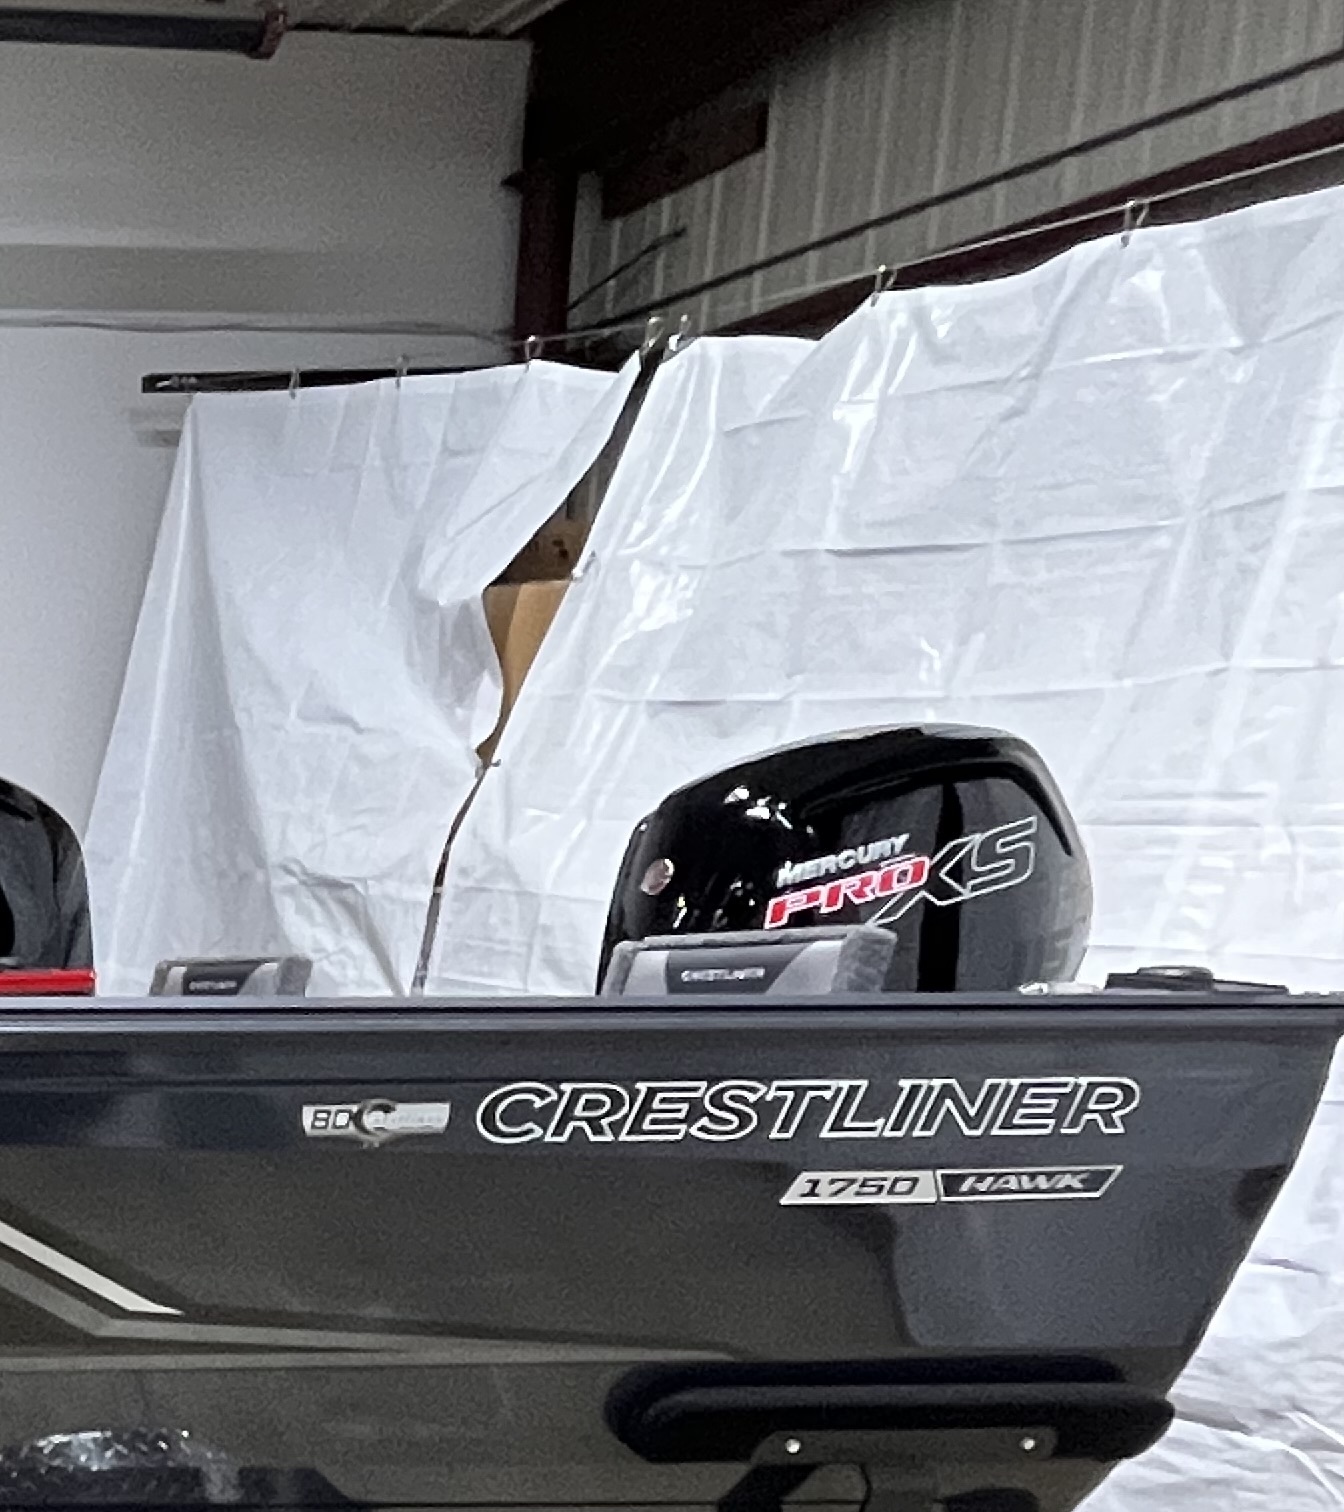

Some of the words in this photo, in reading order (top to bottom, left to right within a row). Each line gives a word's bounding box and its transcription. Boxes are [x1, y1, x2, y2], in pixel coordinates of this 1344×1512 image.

[764, 855, 930, 930] PRO
[865, 814, 1038, 927] XS
[776, 833, 910, 889] MERCURY
[476, 1076, 1141, 1144] CRESTLINER
[799, 1175, 920, 1199] 1750
[958, 1172, 1090, 1194] HAWK
